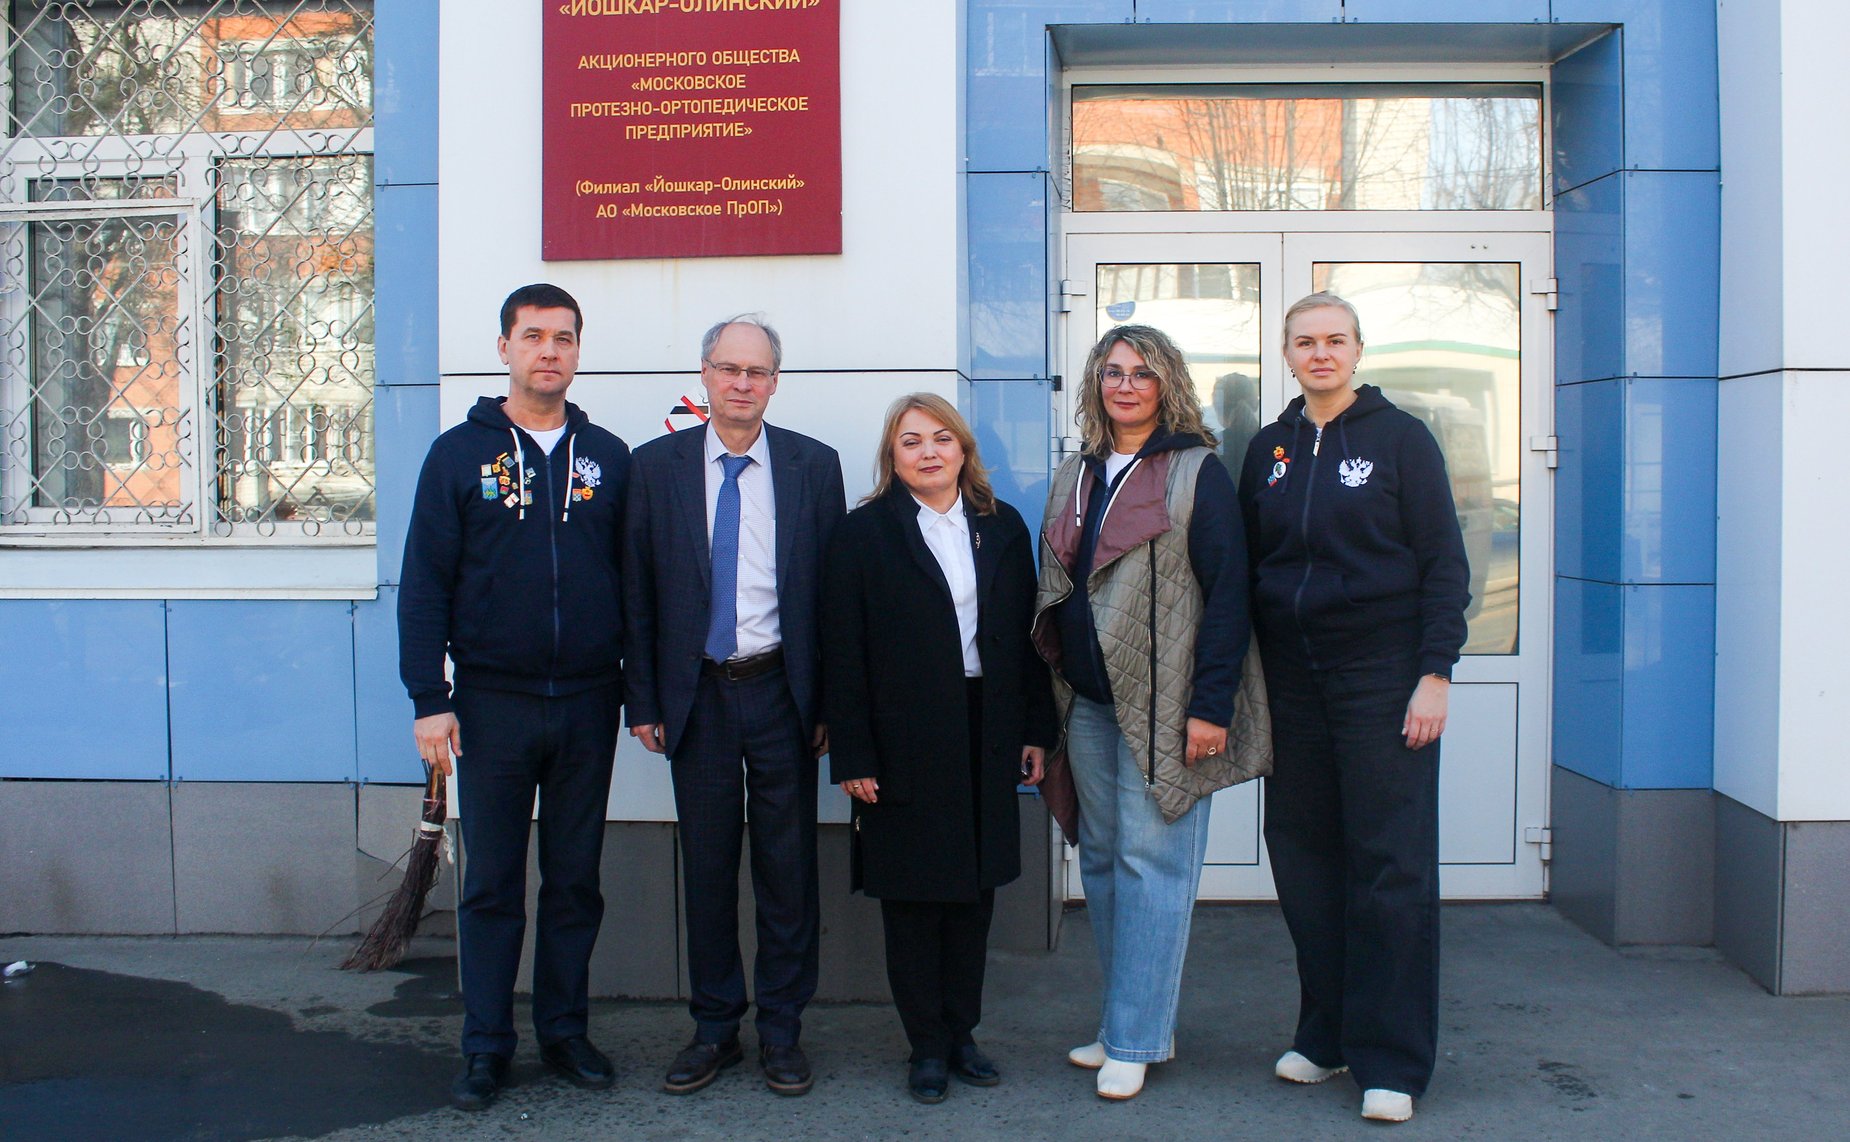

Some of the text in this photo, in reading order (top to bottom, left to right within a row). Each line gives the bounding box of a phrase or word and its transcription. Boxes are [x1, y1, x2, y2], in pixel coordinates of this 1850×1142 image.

[578, 49, 801, 71] АКЦИОНЕРНОГО ОБЩЕСТВА
[632, 74, 746, 91] «МОСКОВСКОЕ
[571, 97, 808, 118] ПРОТЕЗНО-ОРТОПЕДИЧЕСКОЕ
[626, 122, 752, 141] ПРЕДПРИЯТИЕ»
[576, 174, 805, 196] (Филиал «Йошкар-Олинский»
[596, 199, 783, 218] АО «Московское ПрОП»)
